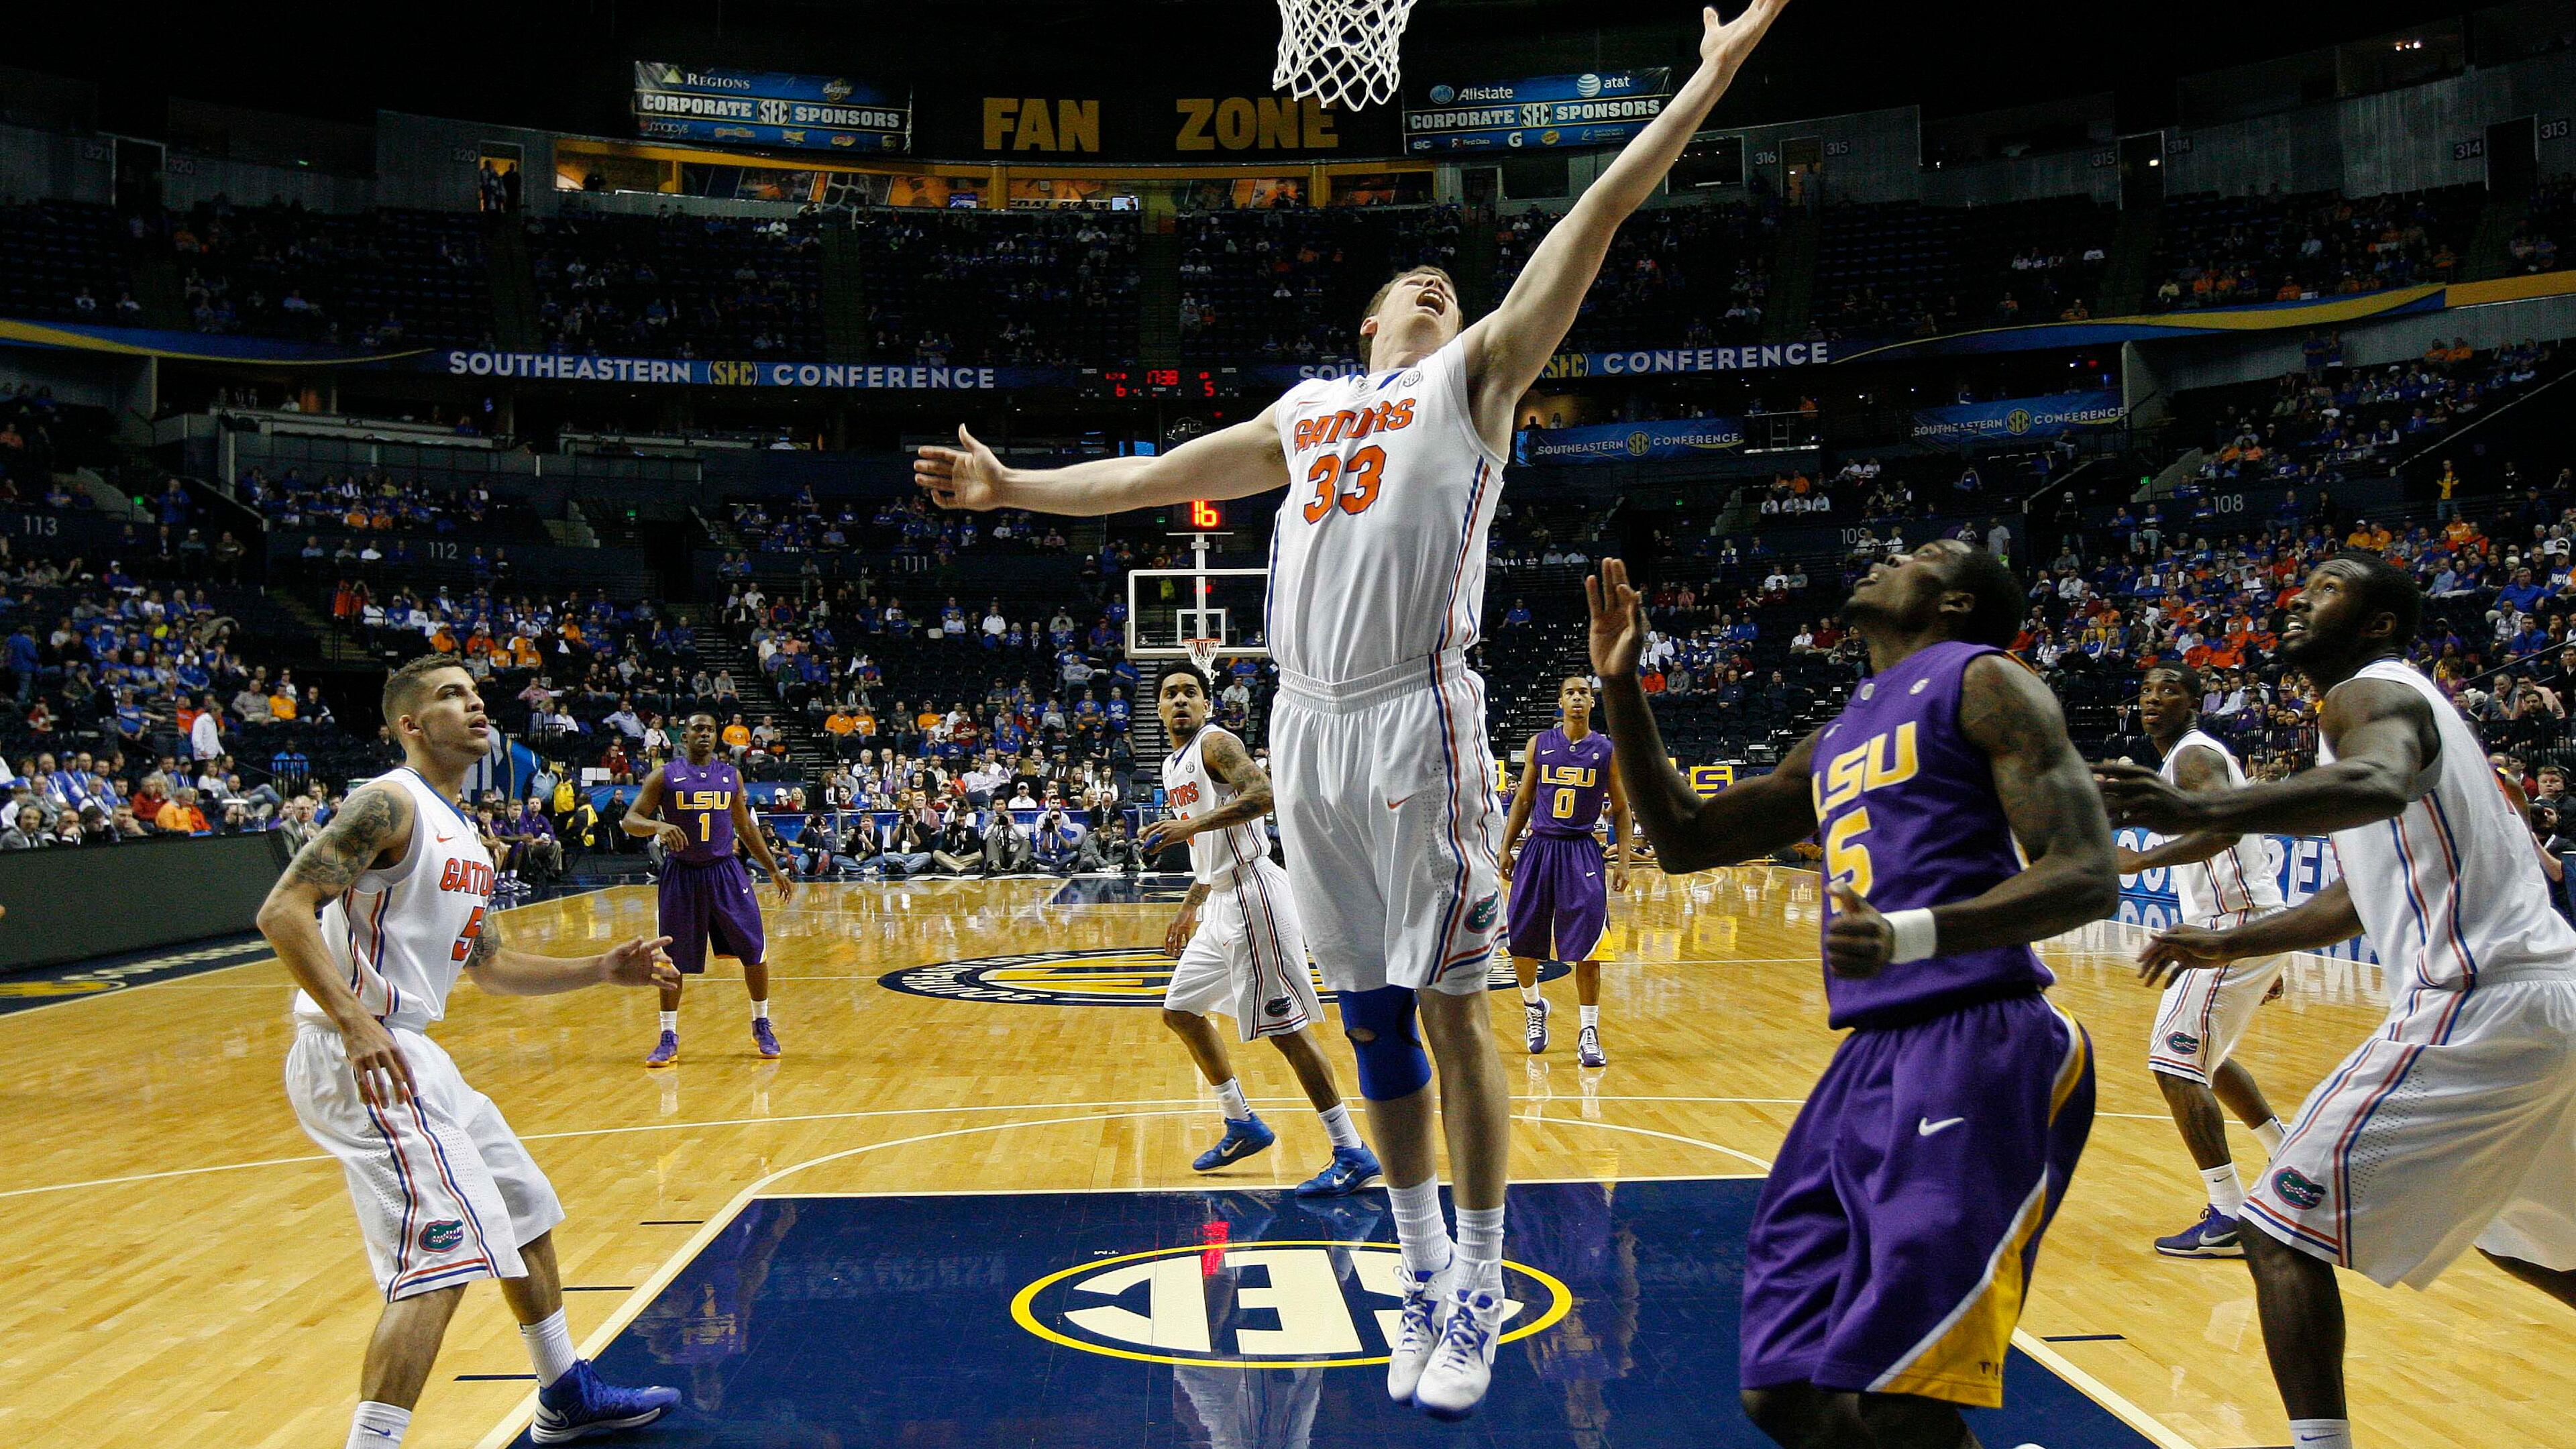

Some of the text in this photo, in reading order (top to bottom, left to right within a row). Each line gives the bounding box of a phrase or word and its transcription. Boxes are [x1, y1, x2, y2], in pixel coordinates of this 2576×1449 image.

[1458, 88, 1513, 102] Allstate
[1604, 75, 1630, 89] at&t
[642, 94, 900, 127] CORPORATE SEC SPONSORS
[983, 97, 1339, 152] FAN ZONE
[1411, 100, 1660, 129] CORPORATE SEC SPONSORS
[2540, 120, 2567, 139] 313
[1754, 152, 1777, 165] 316
[2455, 141, 2481, 159] 314
[449, 351, 692, 384] SOUTHEASTERN
[772, 363, 995, 388] CONFERENCE
[1603, 342, 1829, 374] CONFERENCE
[1295, 398, 1416, 456] GATORS
[1913, 418, 2002, 436] SOUTHEASTERN
[2034, 406, 2125, 425] CONFERENCE
[1538, 439, 1624, 455] SOUTHEASTERN
[1654, 433, 1739, 446] CONFERENCE
[1303, 445, 1387, 524] 33
[1193, 500, 1218, 527] 16
[2213, 494, 2243, 513] 108
[24, 515, 58, 537] 113
[429, 541, 458, 559] 112
[904, 555, 927, 572] 111
[1542, 765, 1596, 787] LSU
[1812, 720, 1919, 825] LSU
[676, 791, 731, 810] LSU
[1552, 788, 1576, 818] 0
[699, 812, 710, 842] 1
[1826, 806, 1873, 913] 5
[439, 858, 494, 896] GATO
[451, 906, 485, 961] 5
